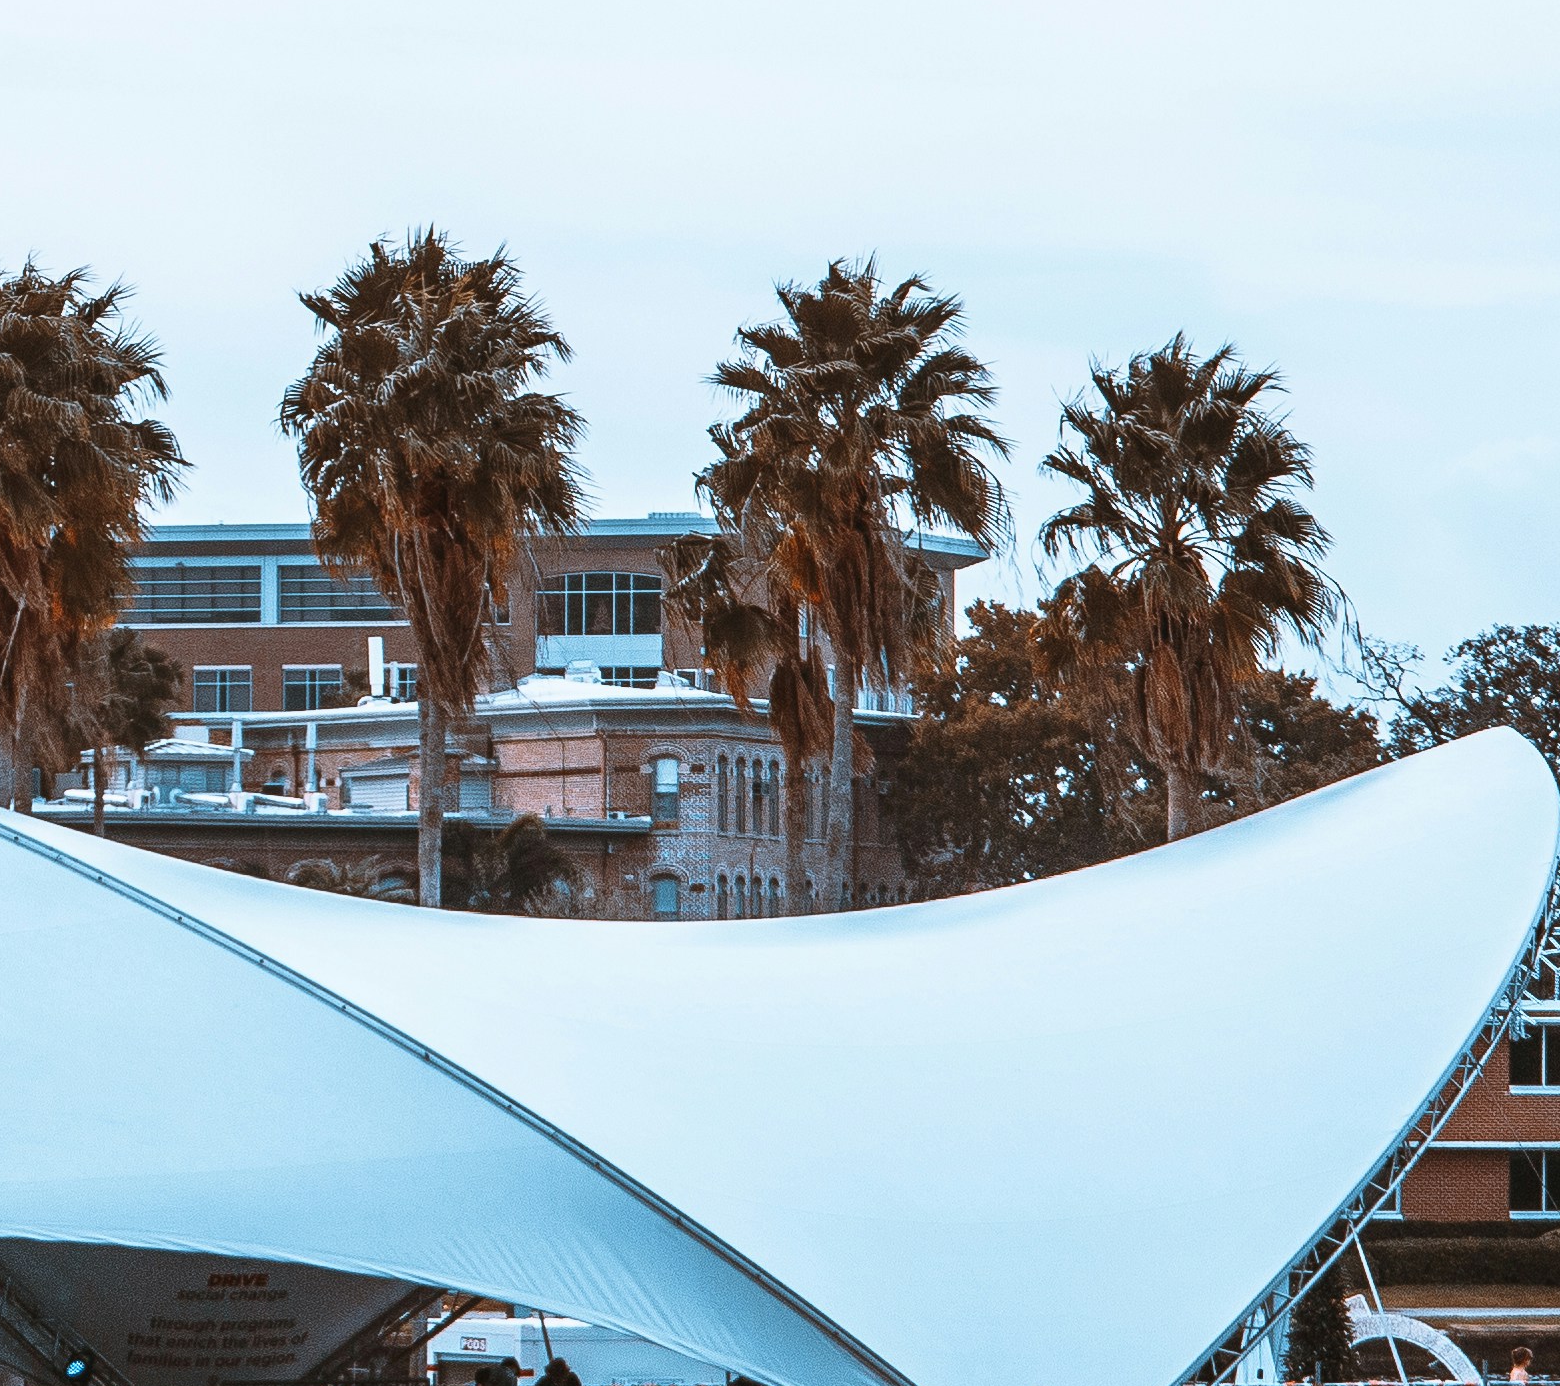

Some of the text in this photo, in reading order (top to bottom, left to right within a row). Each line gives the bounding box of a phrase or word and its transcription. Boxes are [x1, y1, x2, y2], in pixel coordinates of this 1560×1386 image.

[207, 1273, 269, 1287] DRIVE
[177, 1289, 288, 1302] social change
[150, 1316, 296, 1332] through programs
[127, 1331, 309, 1349] that enrich the lives of
